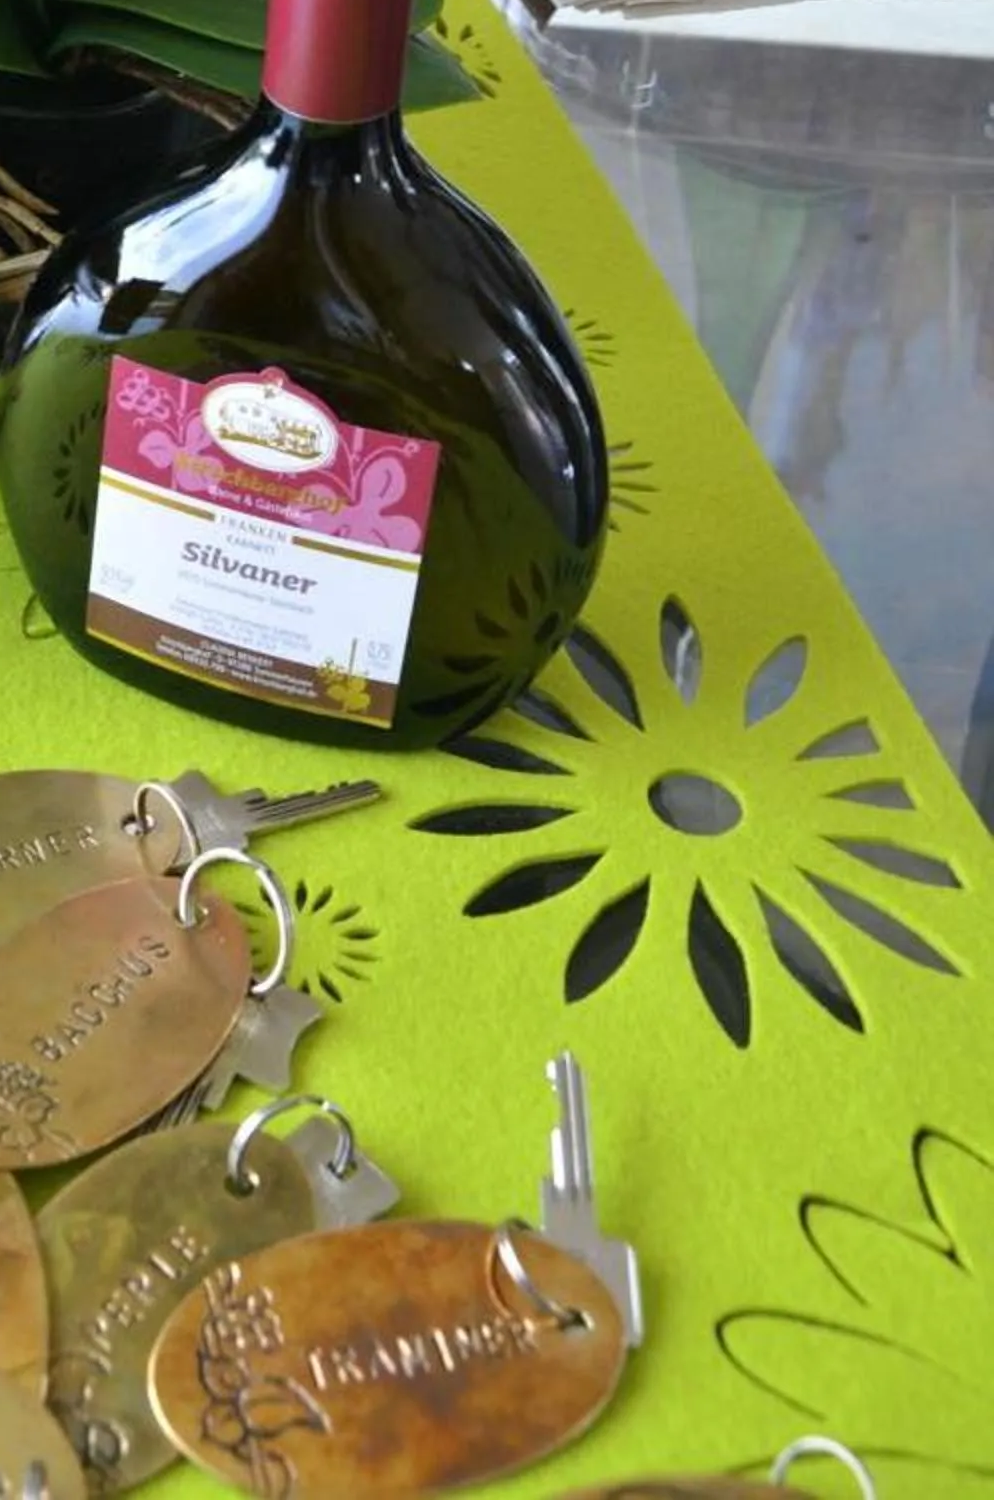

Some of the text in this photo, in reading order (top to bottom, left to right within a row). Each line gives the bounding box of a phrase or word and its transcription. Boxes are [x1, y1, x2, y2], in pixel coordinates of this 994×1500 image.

[181, 541, 319, 595] Silvaner
[31, 933, 171, 1062] BACCHUS
[309, 1315, 540, 1391] TRAMINER
